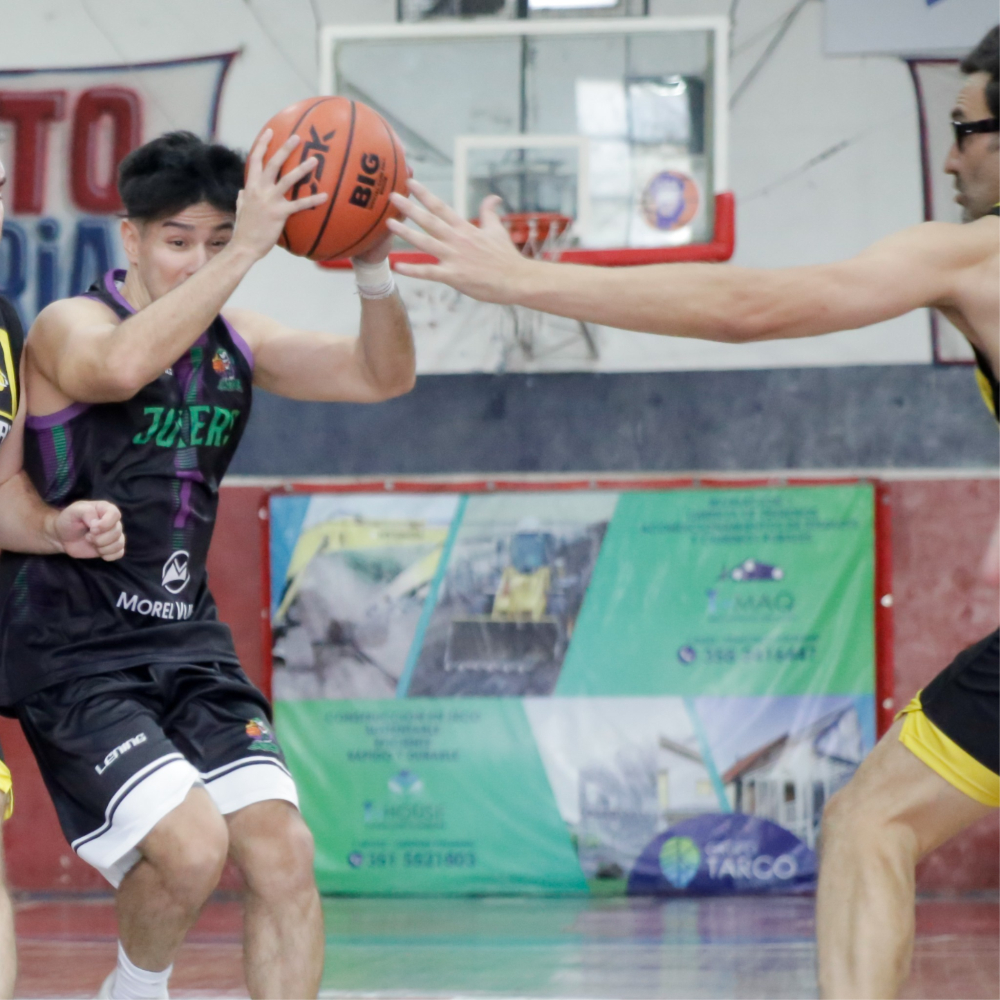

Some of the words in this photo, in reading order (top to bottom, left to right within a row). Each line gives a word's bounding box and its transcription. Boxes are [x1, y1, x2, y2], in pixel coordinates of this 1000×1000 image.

[348, 152, 381, 209] BIG
[115, 591, 174, 620] MOREL
[94, 732, 149, 776] LENING
[706, 853, 798, 881] TARCO
